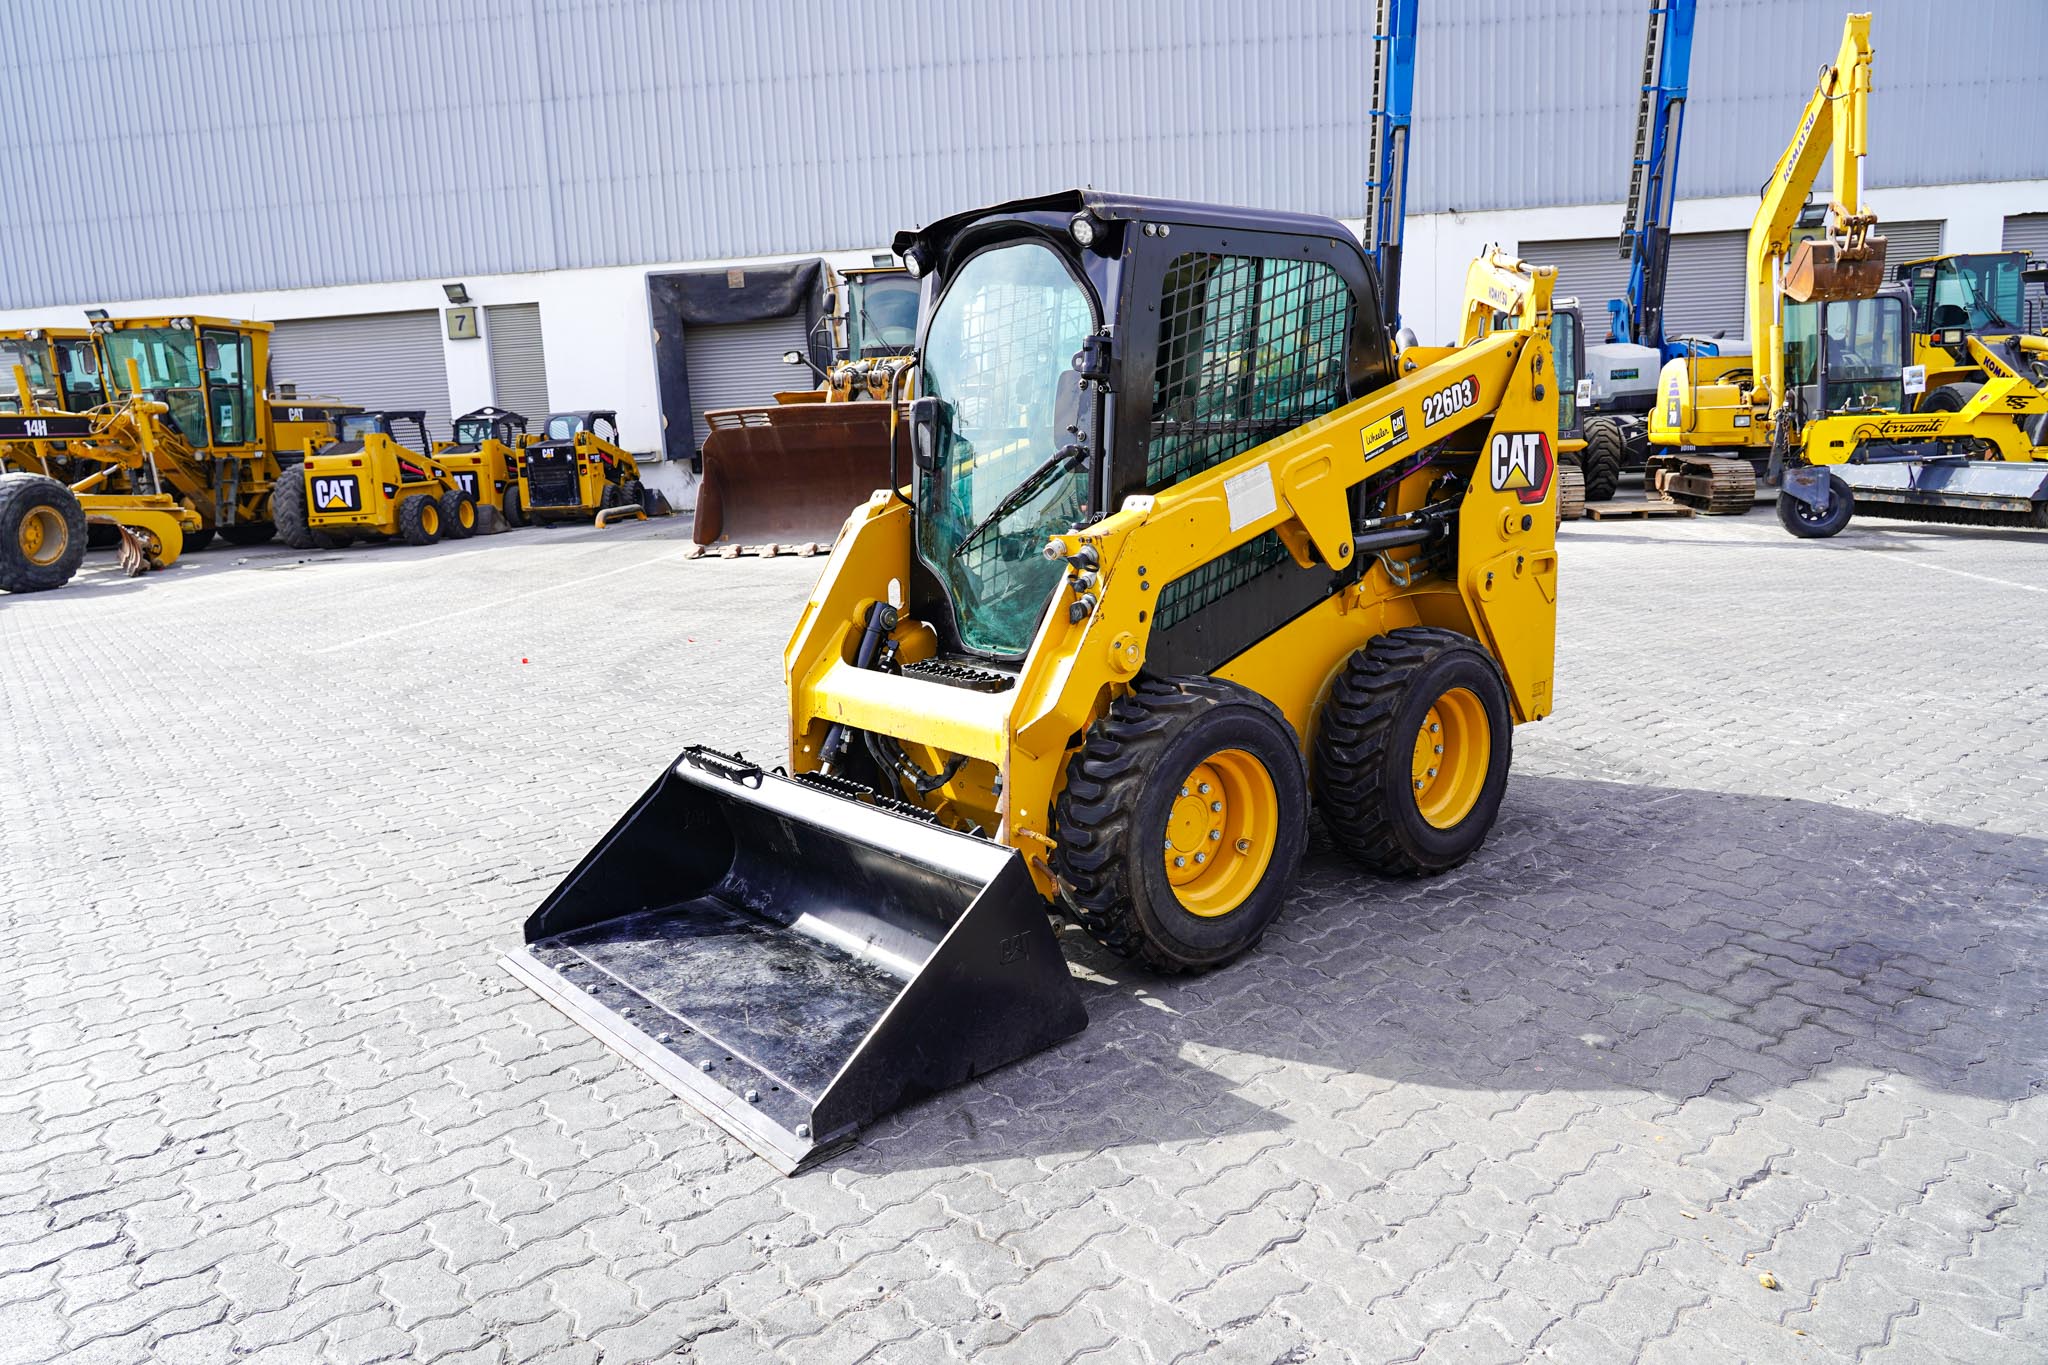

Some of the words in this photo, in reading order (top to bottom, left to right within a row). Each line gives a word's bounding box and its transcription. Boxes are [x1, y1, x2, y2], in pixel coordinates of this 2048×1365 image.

[1783, 112, 1815, 182] KOMATSU
[455, 315, 466, 331] 7
[1983, 356, 2013, 378] KOMA
[288, 407, 304, 421] CAT
[1422, 379, 1473, 427] 226D3
[23, 419, 48, 436] 14H
[1366, 428, 1389, 446] Wheeler
[1392, 415, 1404, 432] CAT
[541, 448, 555, 459] CAT
[1491, 433, 1540, 490] CAT
[315, 479, 354, 509] CAT
